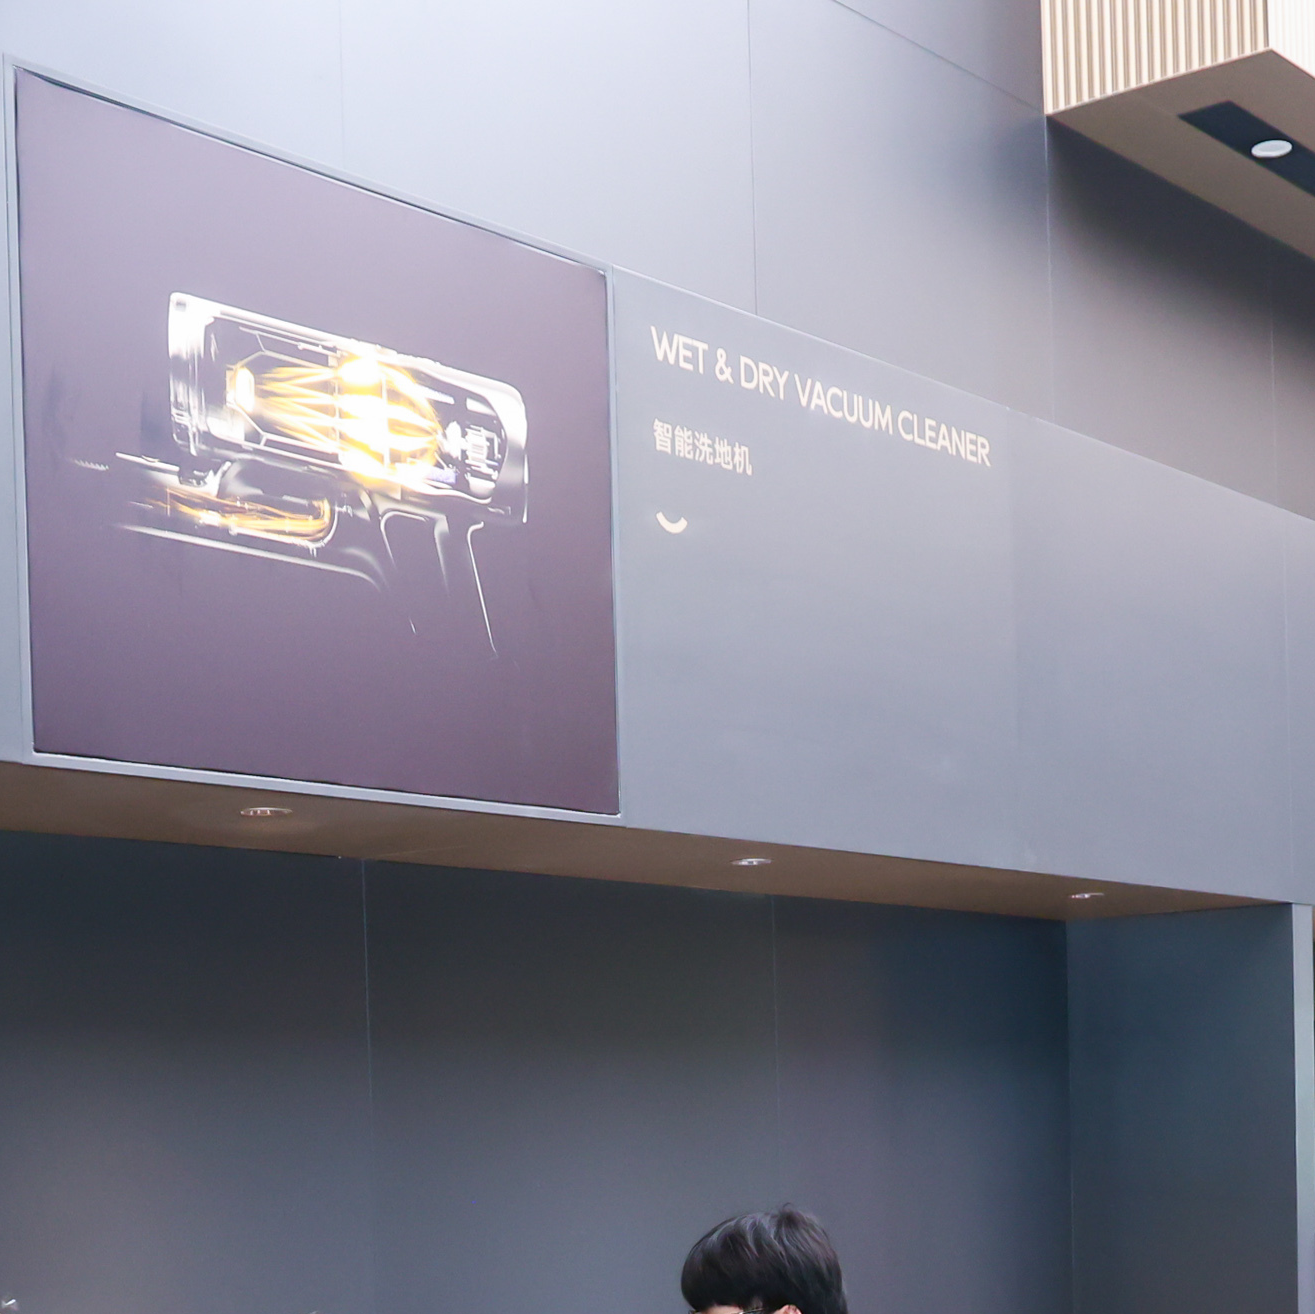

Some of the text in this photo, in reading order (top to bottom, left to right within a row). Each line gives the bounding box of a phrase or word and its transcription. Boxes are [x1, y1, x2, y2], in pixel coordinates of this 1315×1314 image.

[650, 325, 992, 467] WET & DRY VACUUM CLEANER
[652, 418, 753, 475] 智能洗地机
